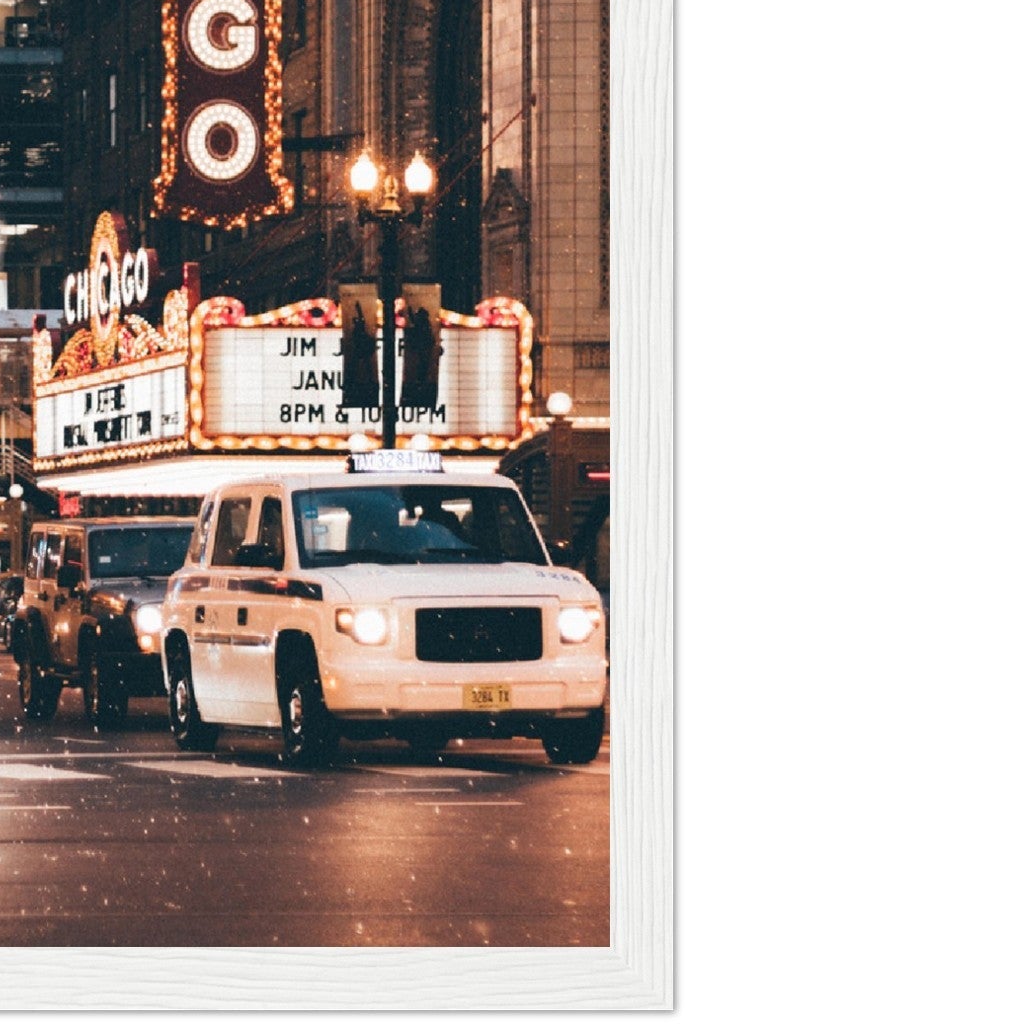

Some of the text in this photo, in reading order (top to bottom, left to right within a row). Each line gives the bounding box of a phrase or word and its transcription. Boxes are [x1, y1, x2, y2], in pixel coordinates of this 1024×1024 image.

[64, 247, 149, 325] CHICAGO
[280, 337, 317, 357] JIM
[280, 403, 325, 424] 8PM
[378, 452, 414, 468] 3284
[472, 689, 493, 703] 3284
